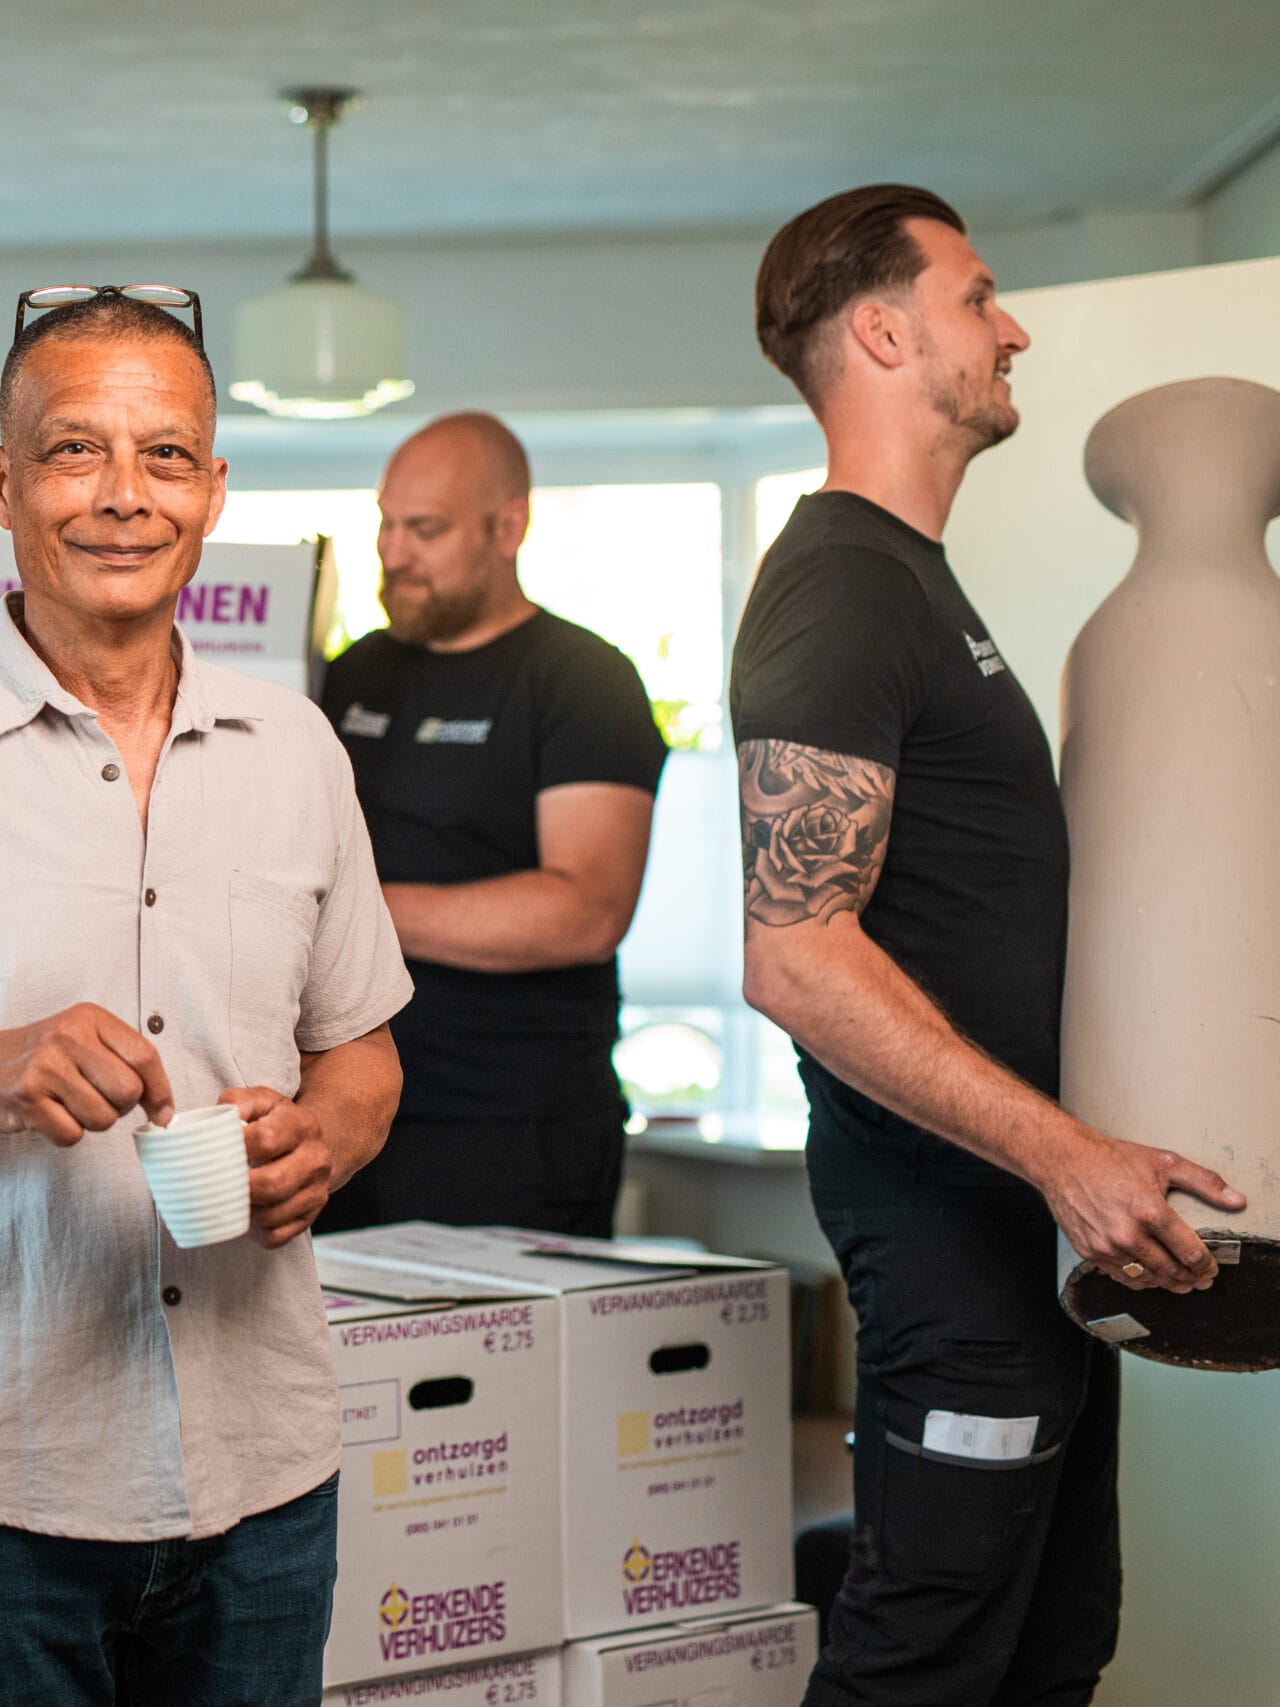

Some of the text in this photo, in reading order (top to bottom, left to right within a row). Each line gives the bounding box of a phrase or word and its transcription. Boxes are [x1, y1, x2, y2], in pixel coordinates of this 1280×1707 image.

[177, 584, 269, 624] NEN
[590, 1278, 769, 1316] VERVANGINGSWAARDE
[340, 1306, 535, 1348] VERVANGINGSWAARDE
[483, 1332, 496, 1353] €
[653, 1400, 744, 1430] ontzorgd
[412, 1431, 508, 1465] ontzorgd
[654, 1426, 744, 1449] verhuizen
[412, 1459, 508, 1486] verhuizen
[652, 1540, 741, 1582] ERKENDE
[411, 1581, 506, 1625] ERKENDE
[623, 1572, 740, 1616] VERHUIZERS
[380, 1613, 506, 1661] VERHUIZERS
[343, 1657, 537, 1706] VERVANGINGSWAARDE
